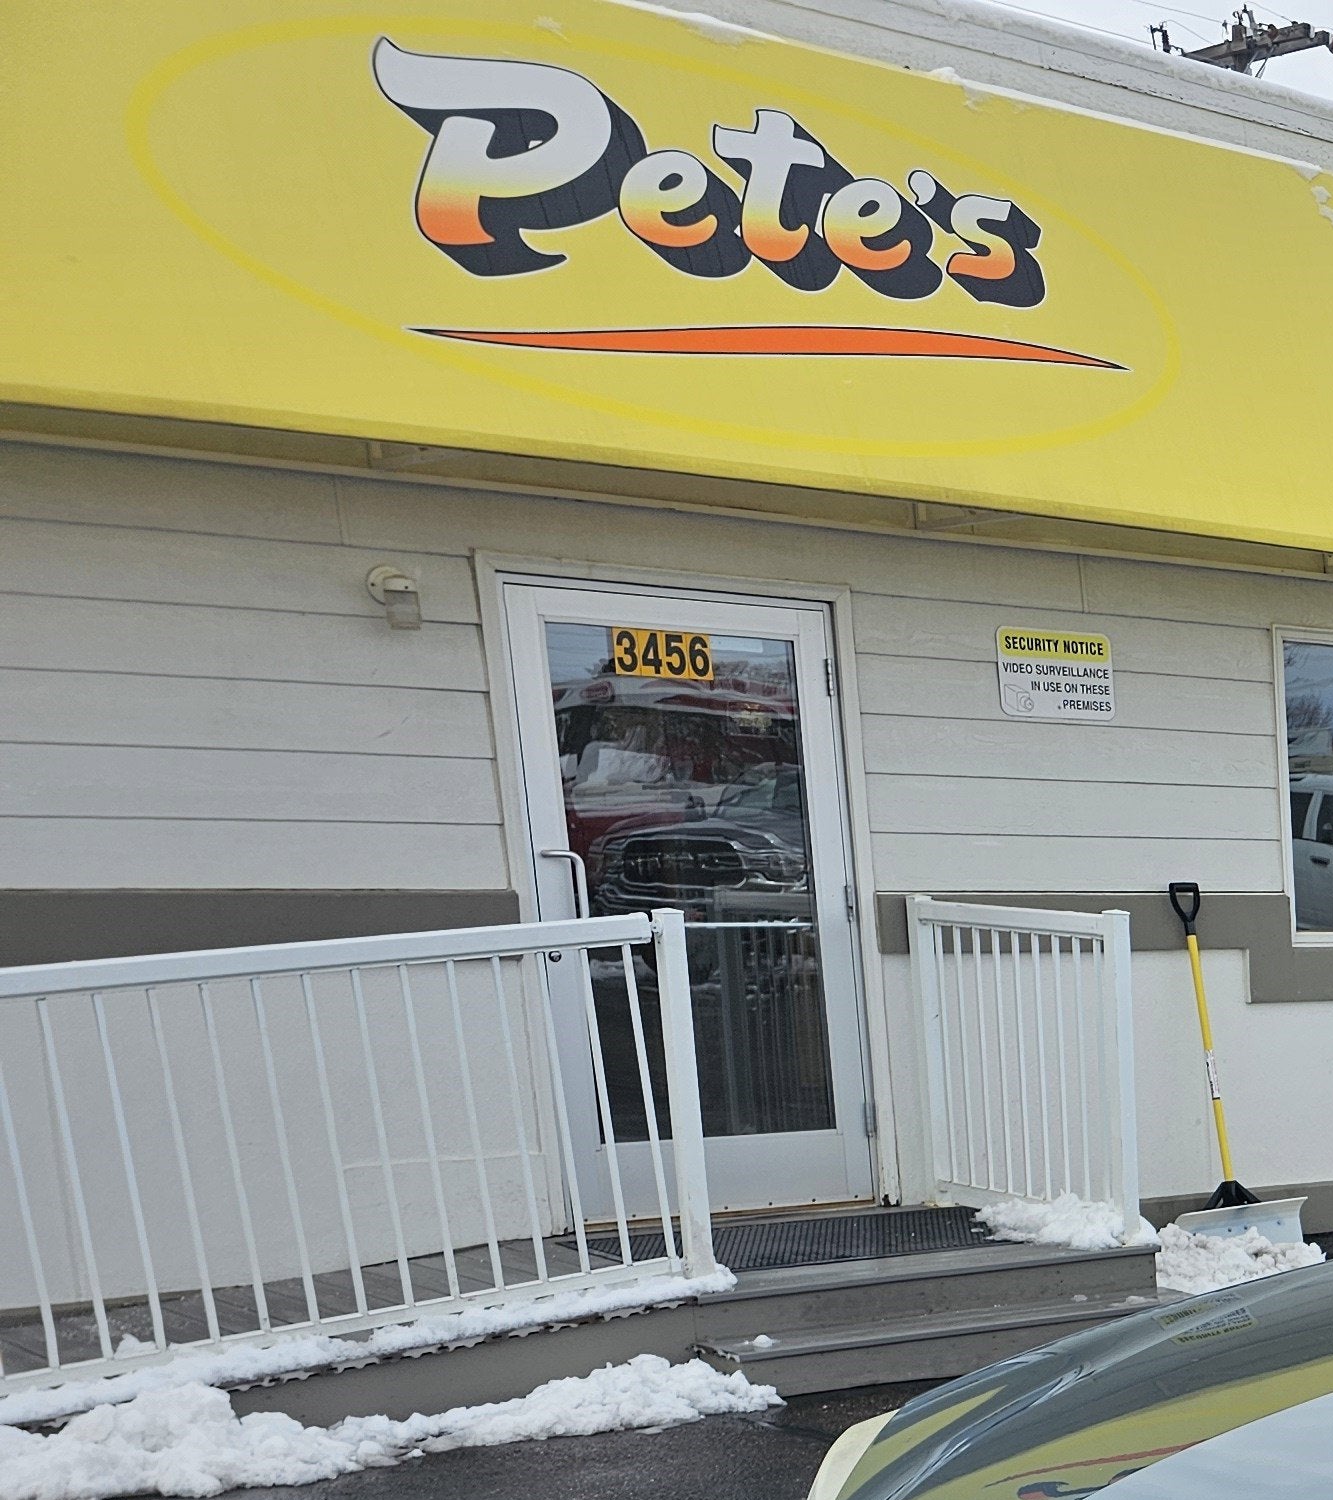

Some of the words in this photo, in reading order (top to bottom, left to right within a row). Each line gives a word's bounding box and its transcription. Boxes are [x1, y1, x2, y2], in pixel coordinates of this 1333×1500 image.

[373, 36, 1046, 308] Pete's
[616, 630, 710, 677] 3456
[1004, 635, 1058, 653] SECURITY
[1063, 640, 1103, 656] NOTICE
[1002, 661, 1032, 675] VIDEO
[1035, 664, 1109, 679] SURVEILLANCE
[1031, 680, 1041, 691] IN
[1043, 681, 1062, 693] USE
[1064, 682, 1078, 694] ON
[1080, 683, 1110, 695] THESE
[1062, 699, 1112, 712] PREMISES
